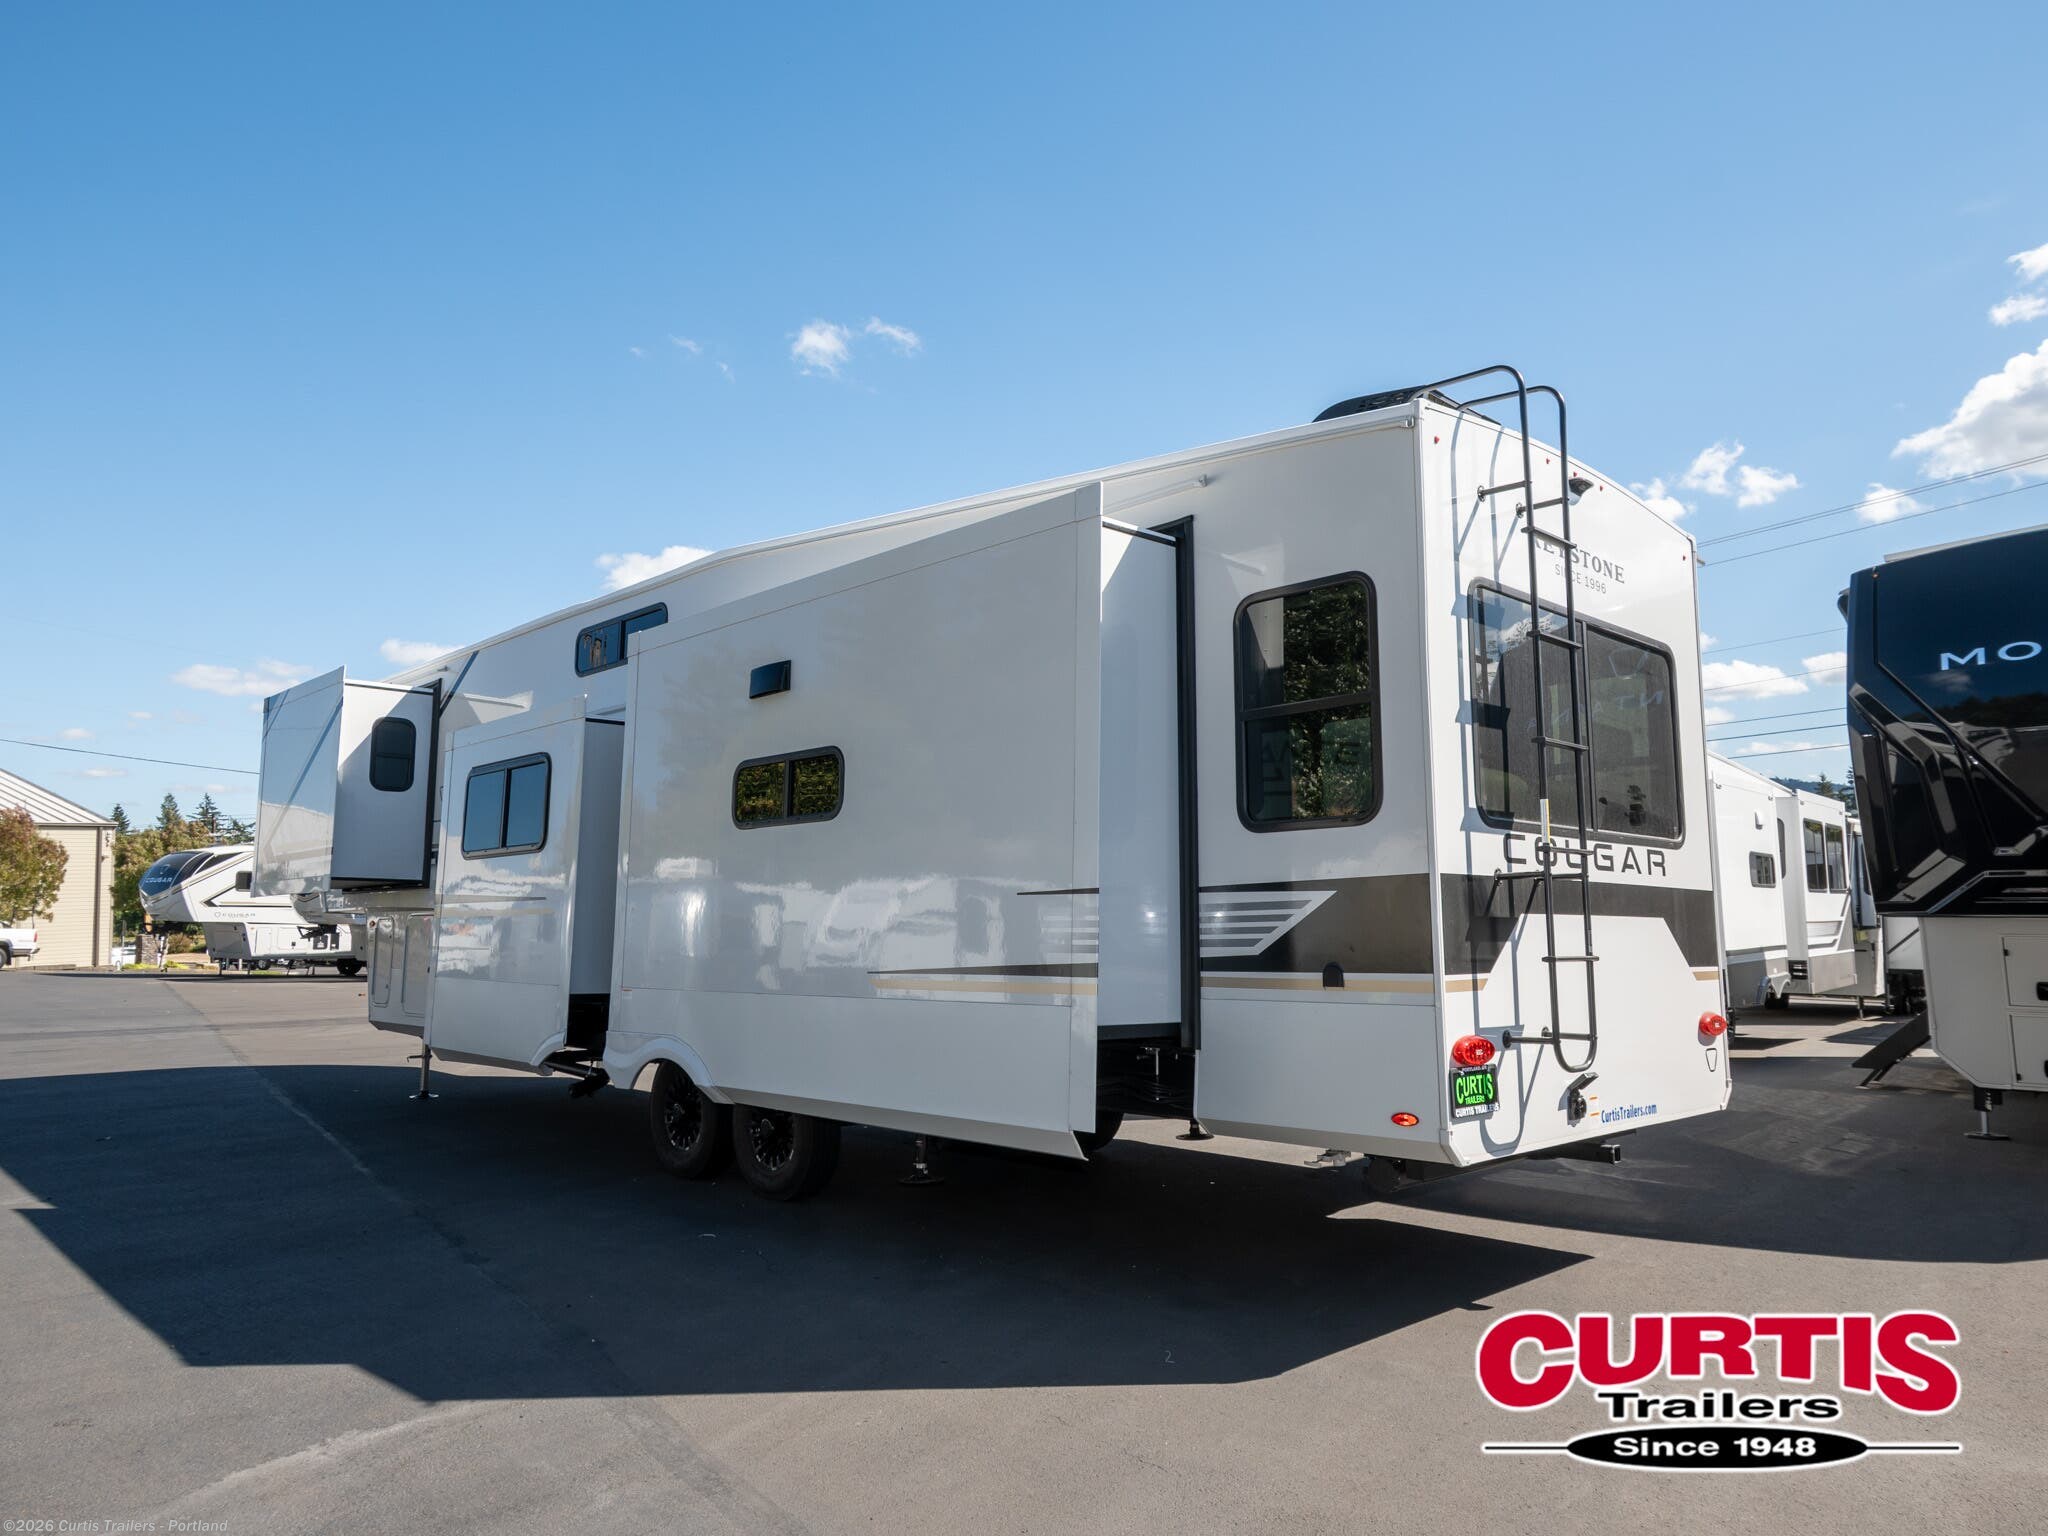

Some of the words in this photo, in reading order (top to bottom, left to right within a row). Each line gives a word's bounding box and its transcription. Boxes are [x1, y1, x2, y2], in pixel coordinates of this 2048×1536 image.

[1554, 563, 1582, 585] SICE
[1584, 576, 1607, 594] 1996
[1940, 641, 2043, 671] MO
[1503, 833, 1666, 876] COUGAR
[1456, 1073, 1494, 1104] CURTIS
[1456, 1107, 1475, 1118] CURTIS
[1601, 1104, 1657, 1123] CurtisTrailers.com
